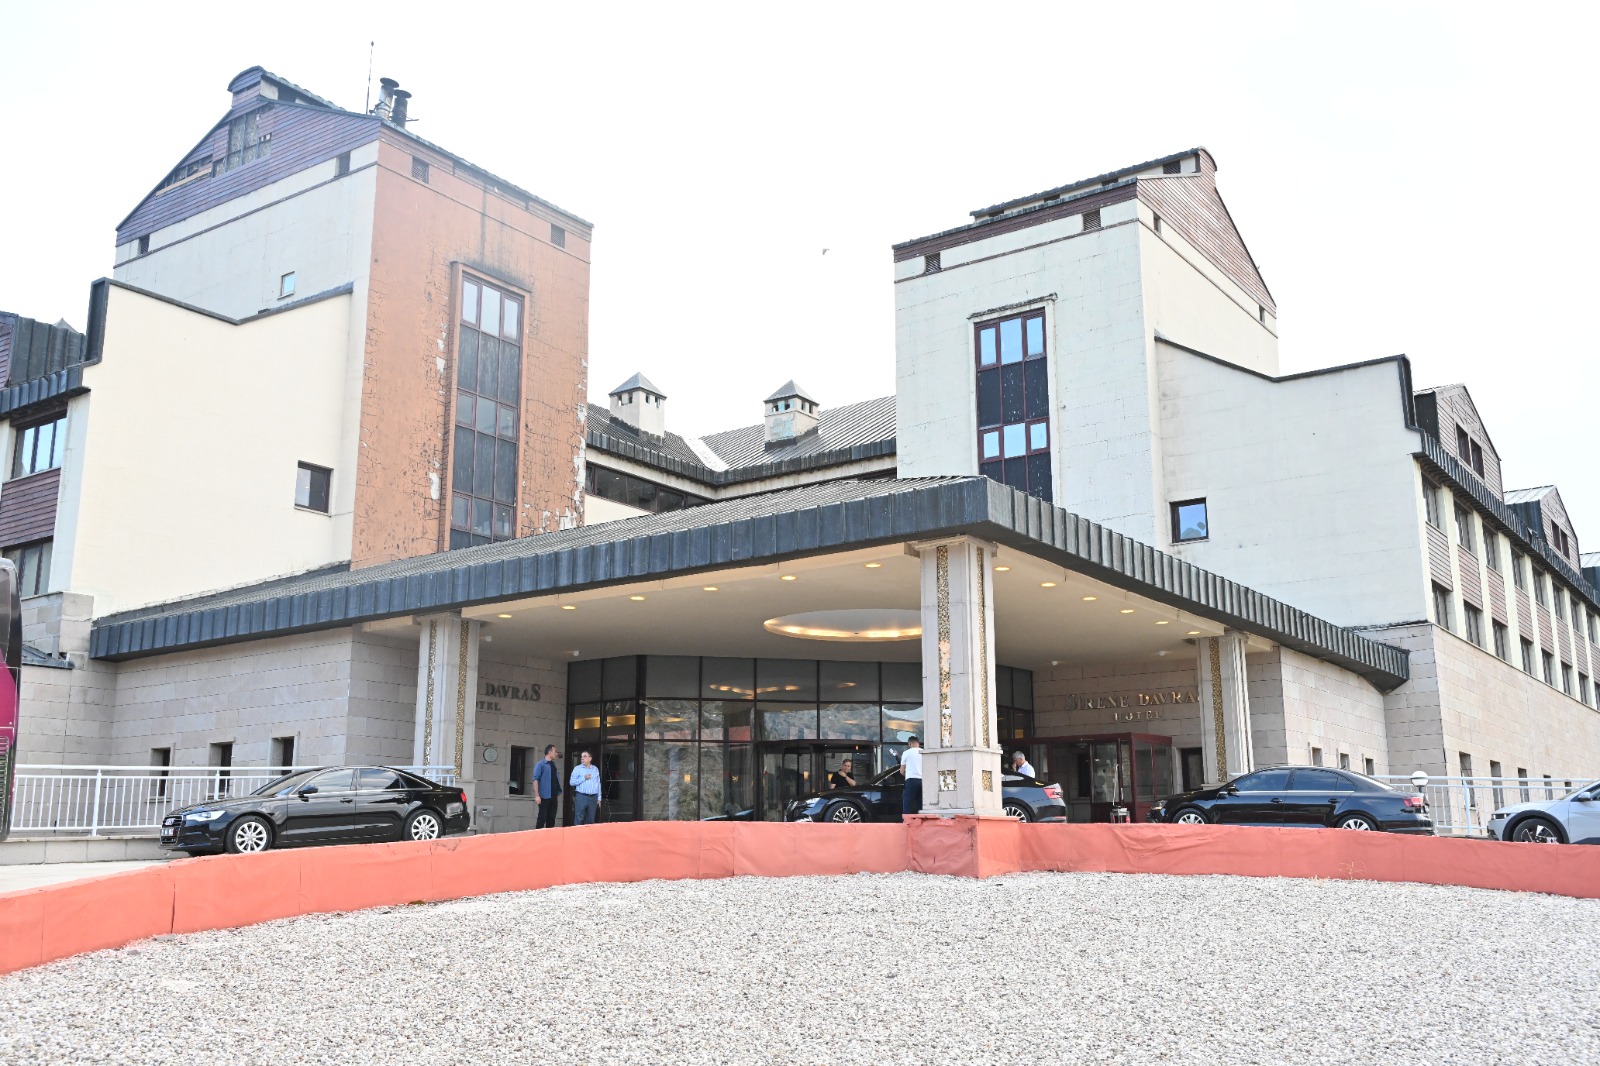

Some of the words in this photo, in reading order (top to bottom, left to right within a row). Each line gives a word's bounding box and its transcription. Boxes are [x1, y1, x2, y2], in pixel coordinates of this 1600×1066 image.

[485, 682, 541, 702] DAVRAS
[1065, 693, 1129, 711] SIRENE
[1138, 690, 1200, 706] DAVRA
[1114, 710, 1162, 721] HOTEL
